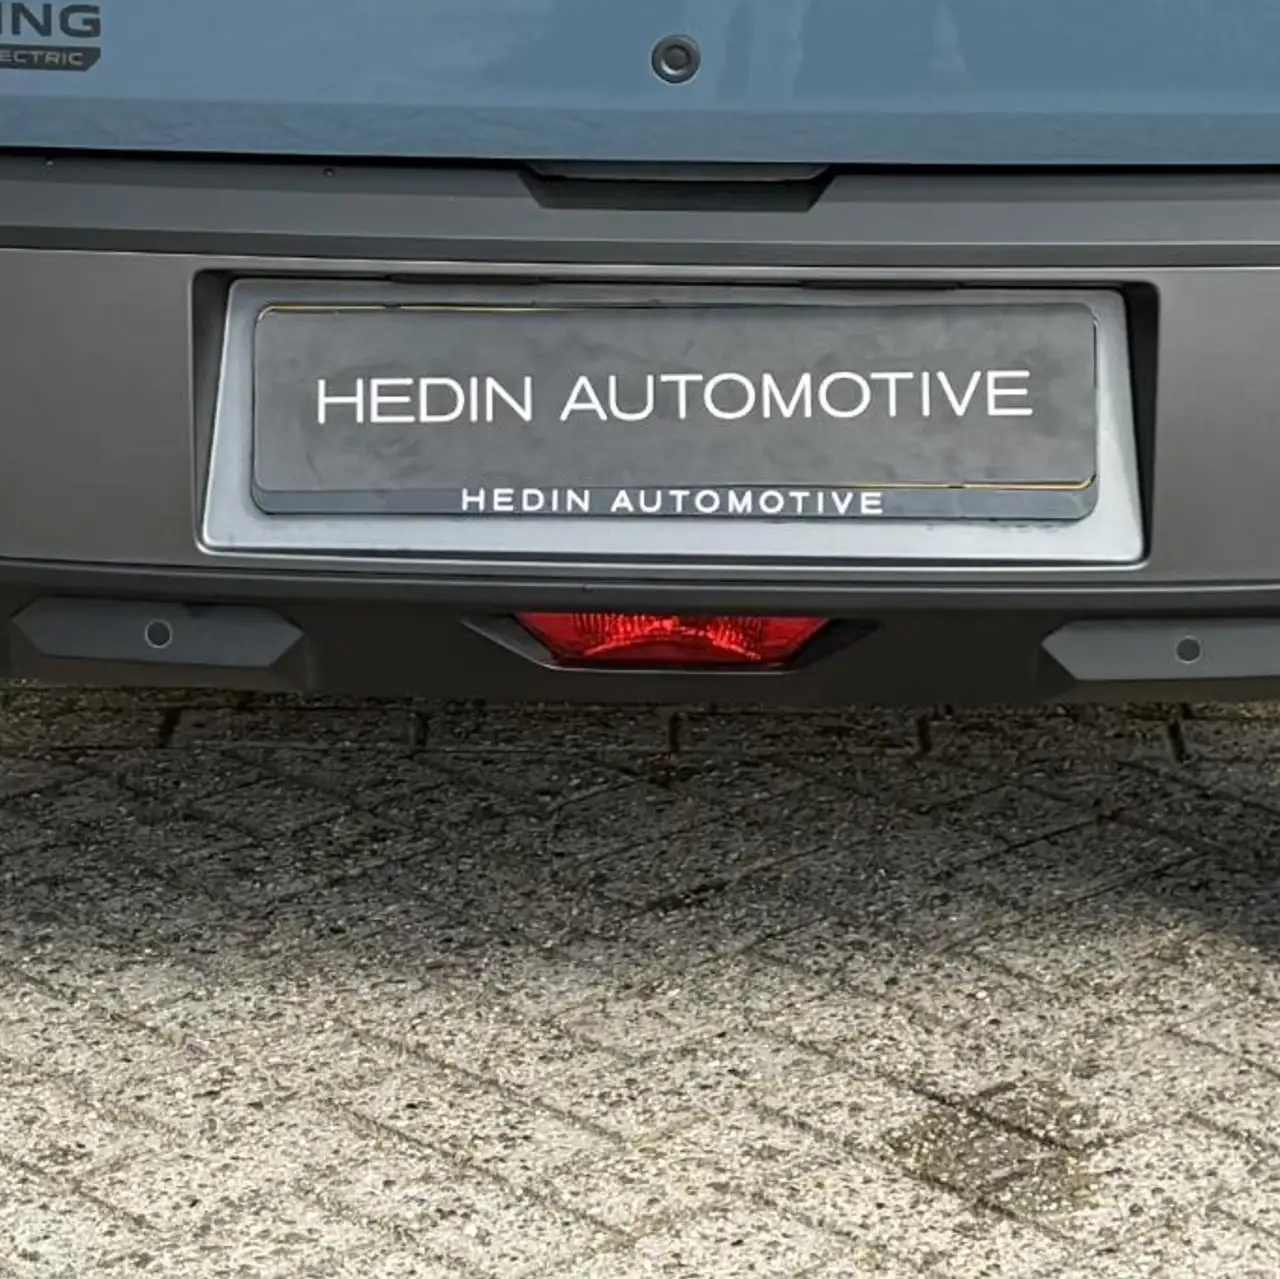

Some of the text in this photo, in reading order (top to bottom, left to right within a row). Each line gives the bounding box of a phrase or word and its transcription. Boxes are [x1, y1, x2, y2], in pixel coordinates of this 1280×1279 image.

[317, 370, 1034, 425] HEDIN AUTOMOTIVE
[461, 487, 884, 516] HEDIN AUTOMOTIVE
